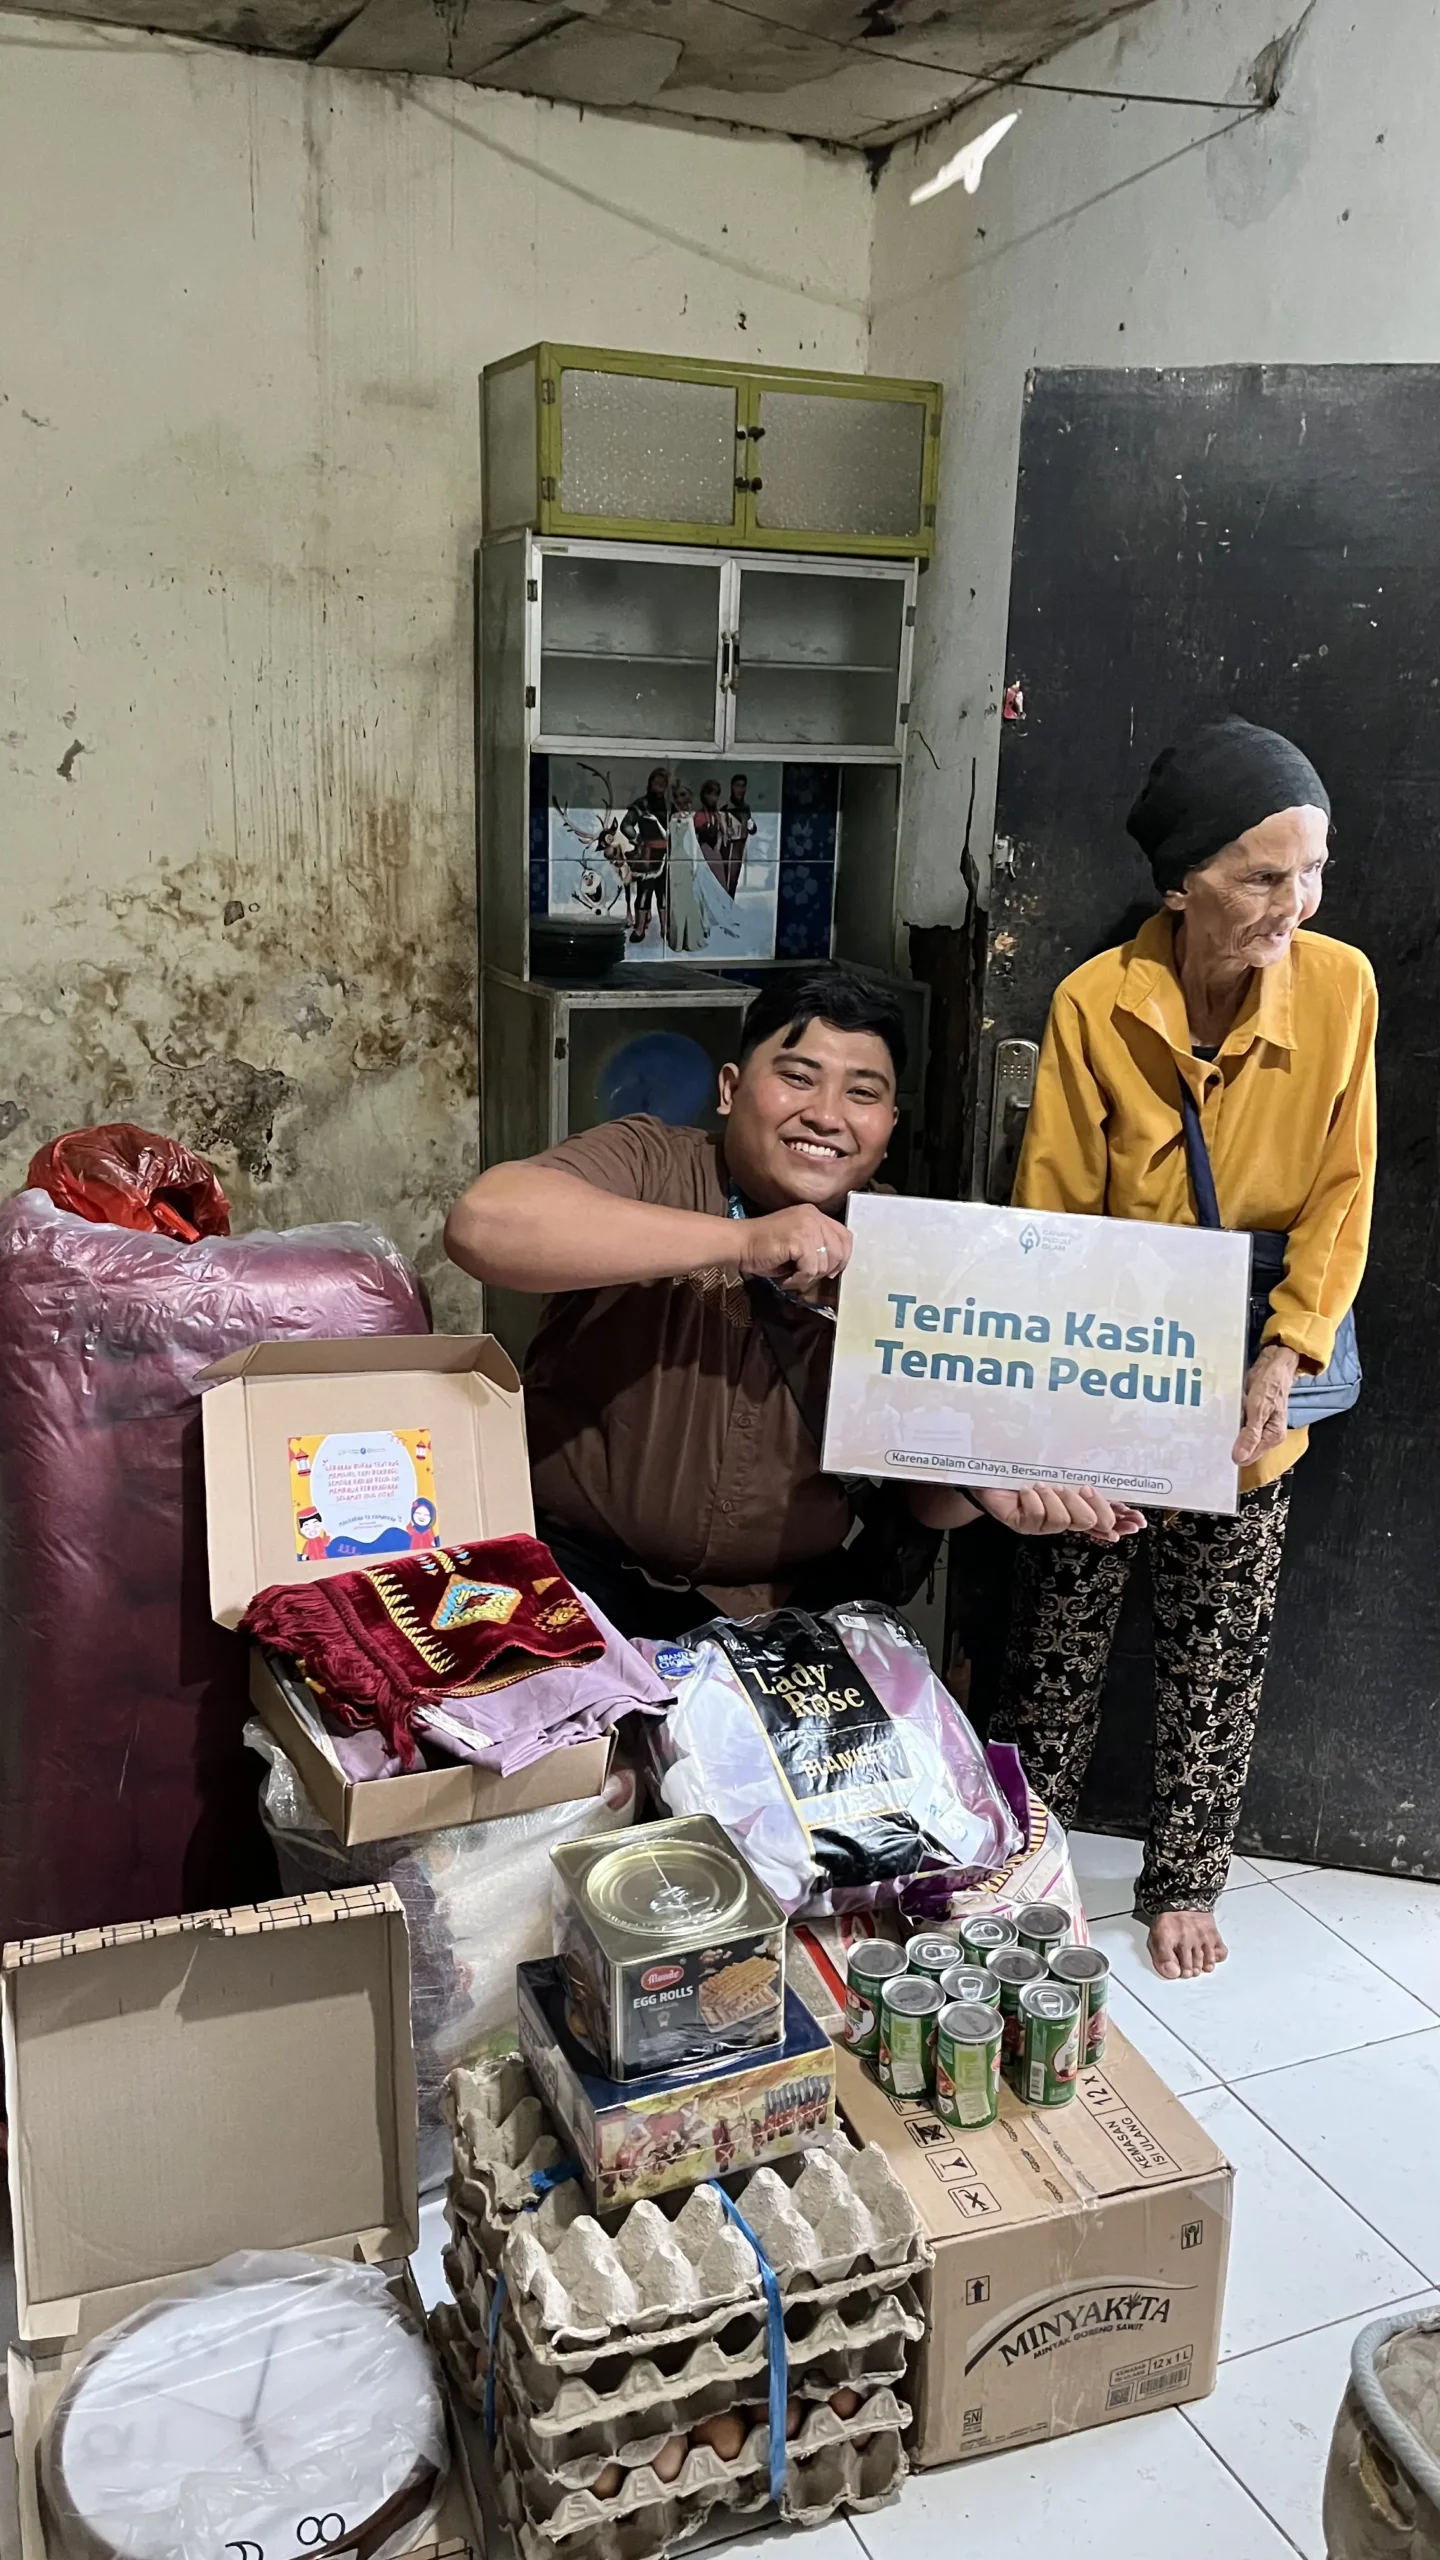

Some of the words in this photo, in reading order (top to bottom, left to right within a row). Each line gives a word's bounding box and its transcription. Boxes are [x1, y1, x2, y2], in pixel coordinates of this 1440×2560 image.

[887, 1293, 1051, 1344] Terima
[1064, 1311, 1196, 1359] Kasih
[874, 1339, 1034, 1390] Teman
[1048, 1356, 1203, 1407] Peduli
[892, 1452, 930, 1467] Karena
[931, 1455, 966, 1470] Dalam
[967, 1458, 1010, 1475] Cahaya,
[1012, 1462, 1059, 1480] Bersama
[1060, 1468, 1101, 1486] Terangi
[1102, 1472, 1164, 1492] Kepedulian
[751, 1662, 828, 1697] Lady
[784, 1684, 866, 1722] Rose
[633, 1994, 657, 2009] EGG
[660, 1986, 694, 2003] ROLLS
[1087, 2088, 1113, 2106] 12
[1105, 2121, 1152, 2170] KEMASAN
[1121, 2117, 1155, 2151] ULANG
[1153, 2152, 1168, 2166] ISI
[1033, 2337, 1072, 2359] MINYAK
[1073, 2323, 1114, 2341] GORENG
[1115, 2322, 1144, 2334] SAWIT
[1153, 2358, 1164, 2370] 12
[964, 2411, 982, 2424] SNI
